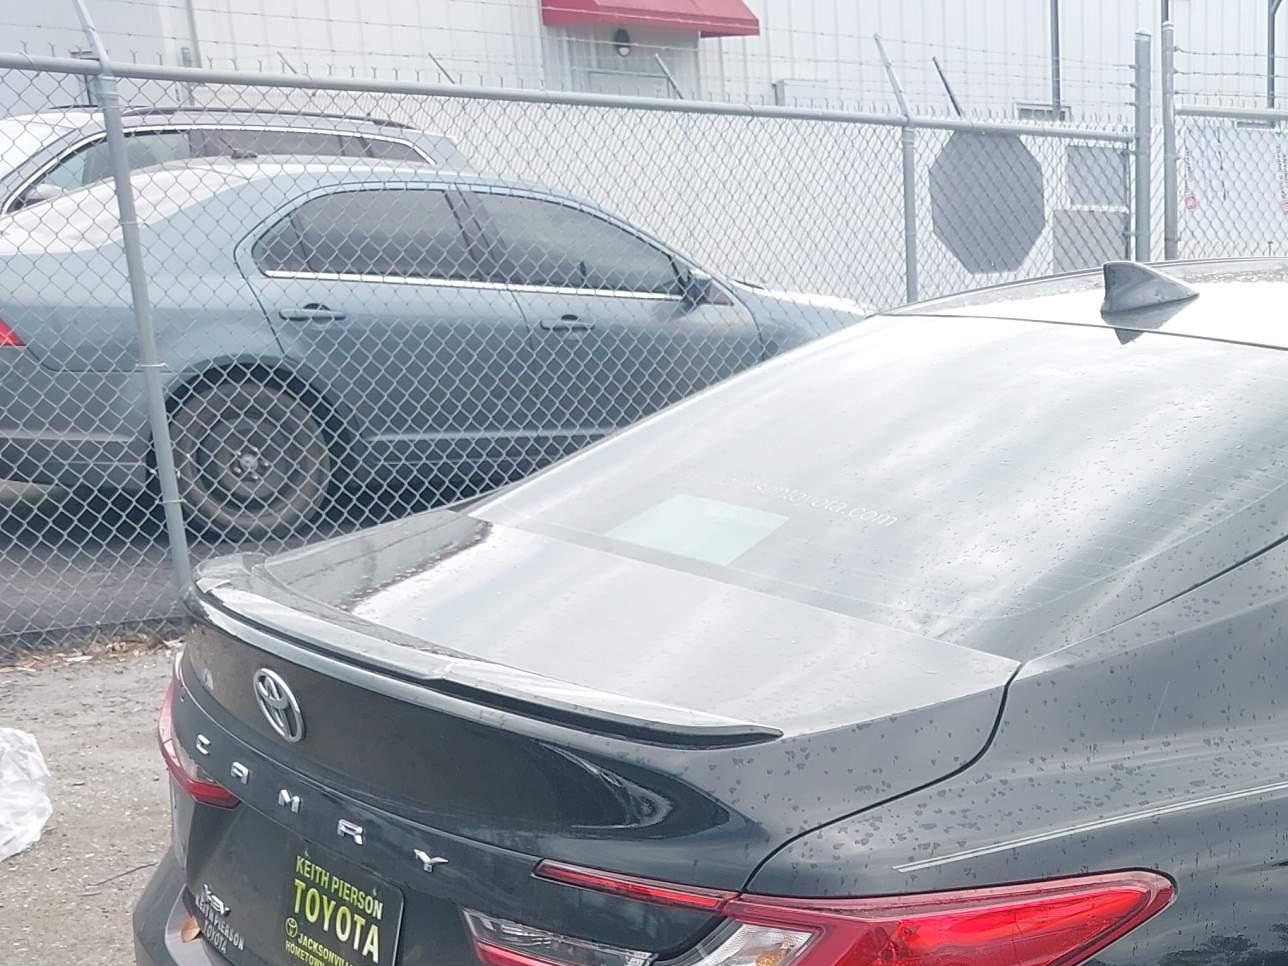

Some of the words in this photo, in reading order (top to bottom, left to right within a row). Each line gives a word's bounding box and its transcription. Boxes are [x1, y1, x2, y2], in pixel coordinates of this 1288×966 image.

[196, 734, 449, 873] CAMRY
[293, 878, 380, 964] TOYOTA
[295, 855, 330, 889] KEITH
[331, 875, 384, 921] PIERSON
